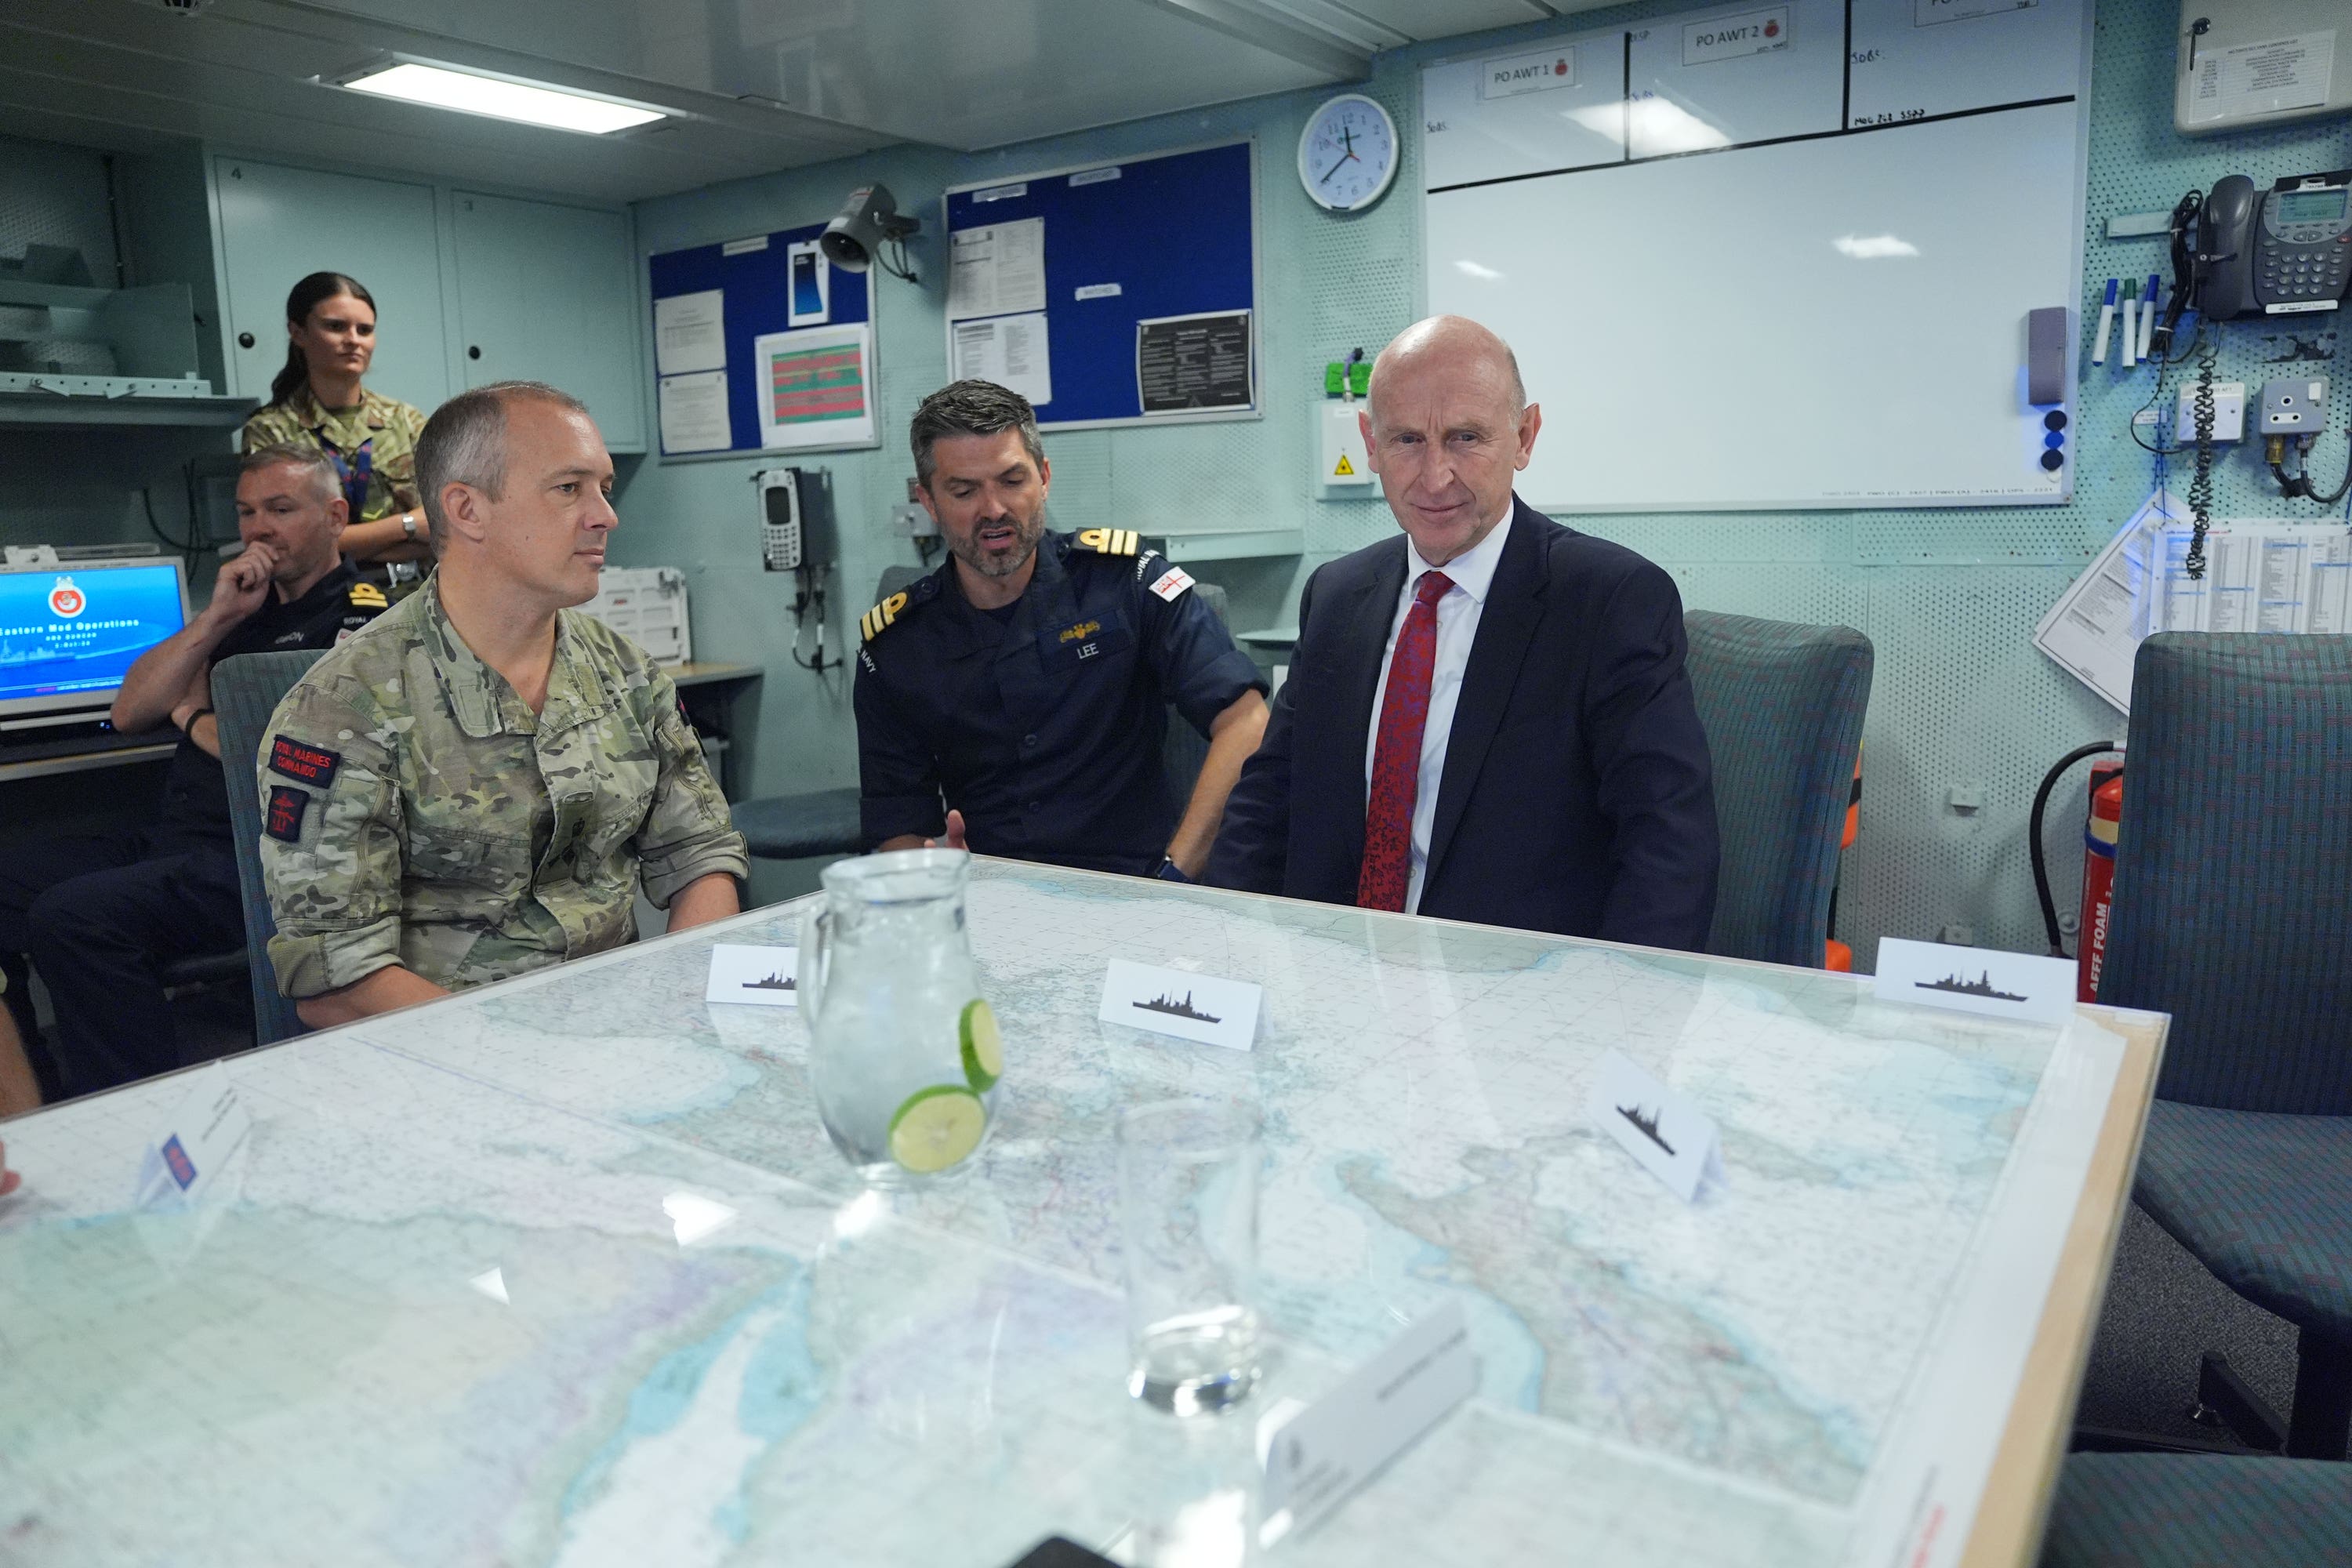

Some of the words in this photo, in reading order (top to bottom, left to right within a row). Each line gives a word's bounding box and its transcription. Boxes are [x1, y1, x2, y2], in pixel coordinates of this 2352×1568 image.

[1696, 34, 1714, 47] PO
[1716, 27, 1748, 44] AWT
[1751, 25, 1759, 38] 2
[1494, 71, 1511, 83] PO
[1512, 65, 1540, 80] AWT
[1543, 64, 1549, 75] 1
[860, 649, 877, 673] NAVY
[1076, 643, 1100, 659] LEE
[278, 754, 317, 779] COMMANDO
[293, 746, 332, 768] MARINES
[2092, 902, 2107, 950] FOAM
[2089, 953, 2102, 993] AFFF
